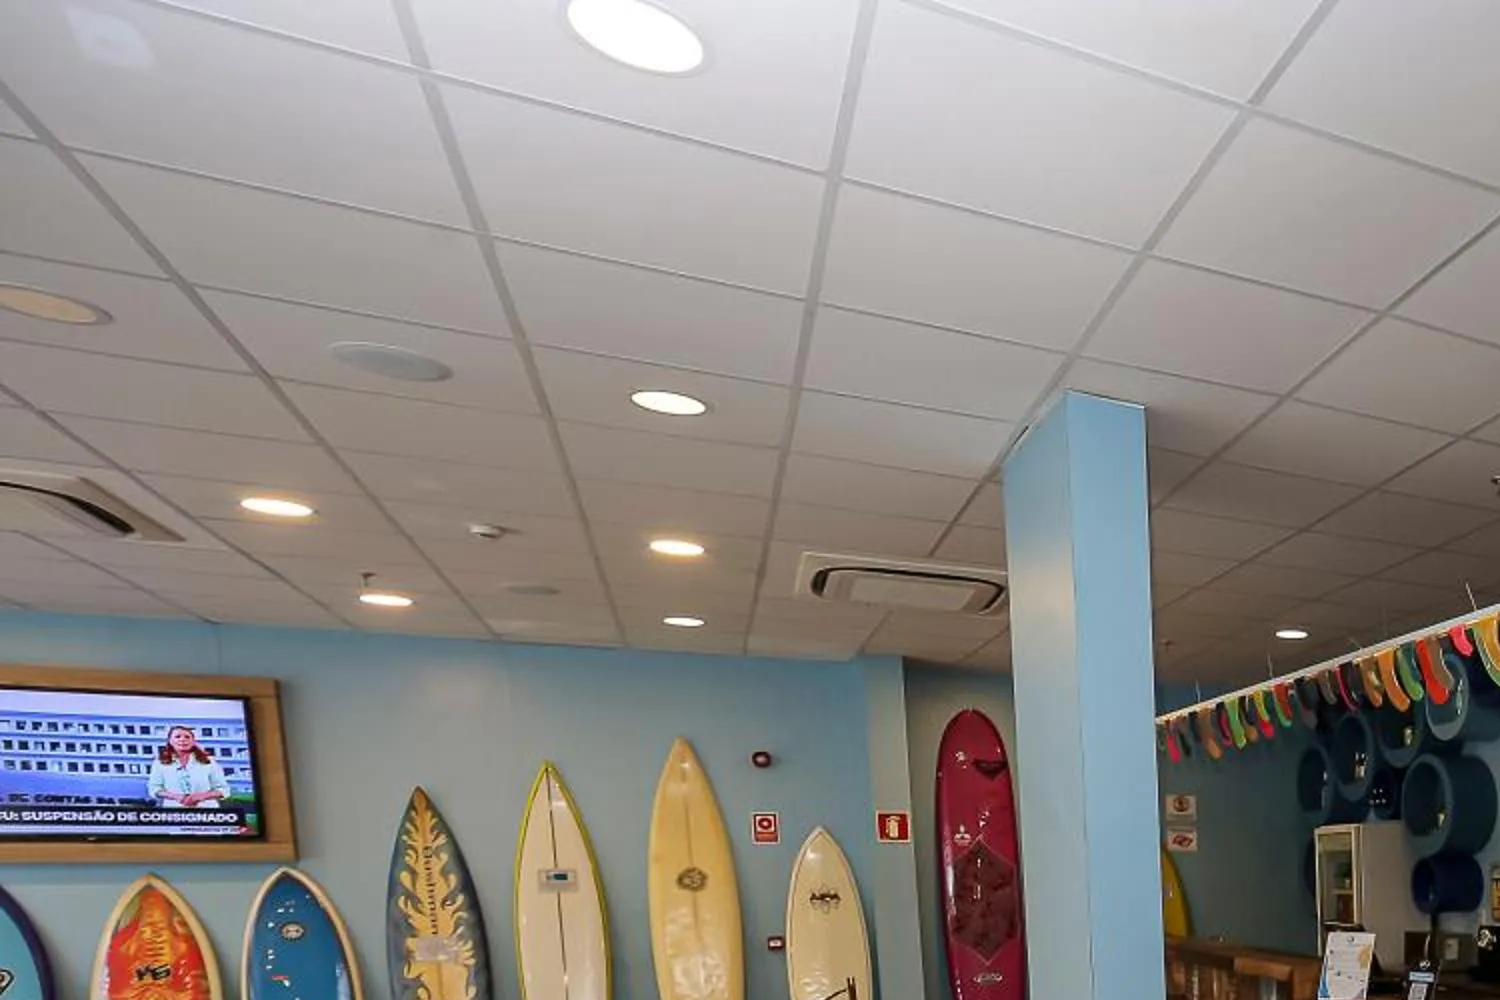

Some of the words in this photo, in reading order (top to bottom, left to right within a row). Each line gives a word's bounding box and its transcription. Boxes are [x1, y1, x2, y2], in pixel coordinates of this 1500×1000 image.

[21, 810, 115, 821] SUSPENSÃO
[117, 811, 138, 822] DE
[140, 812, 238, 823] CONSIGNADO
